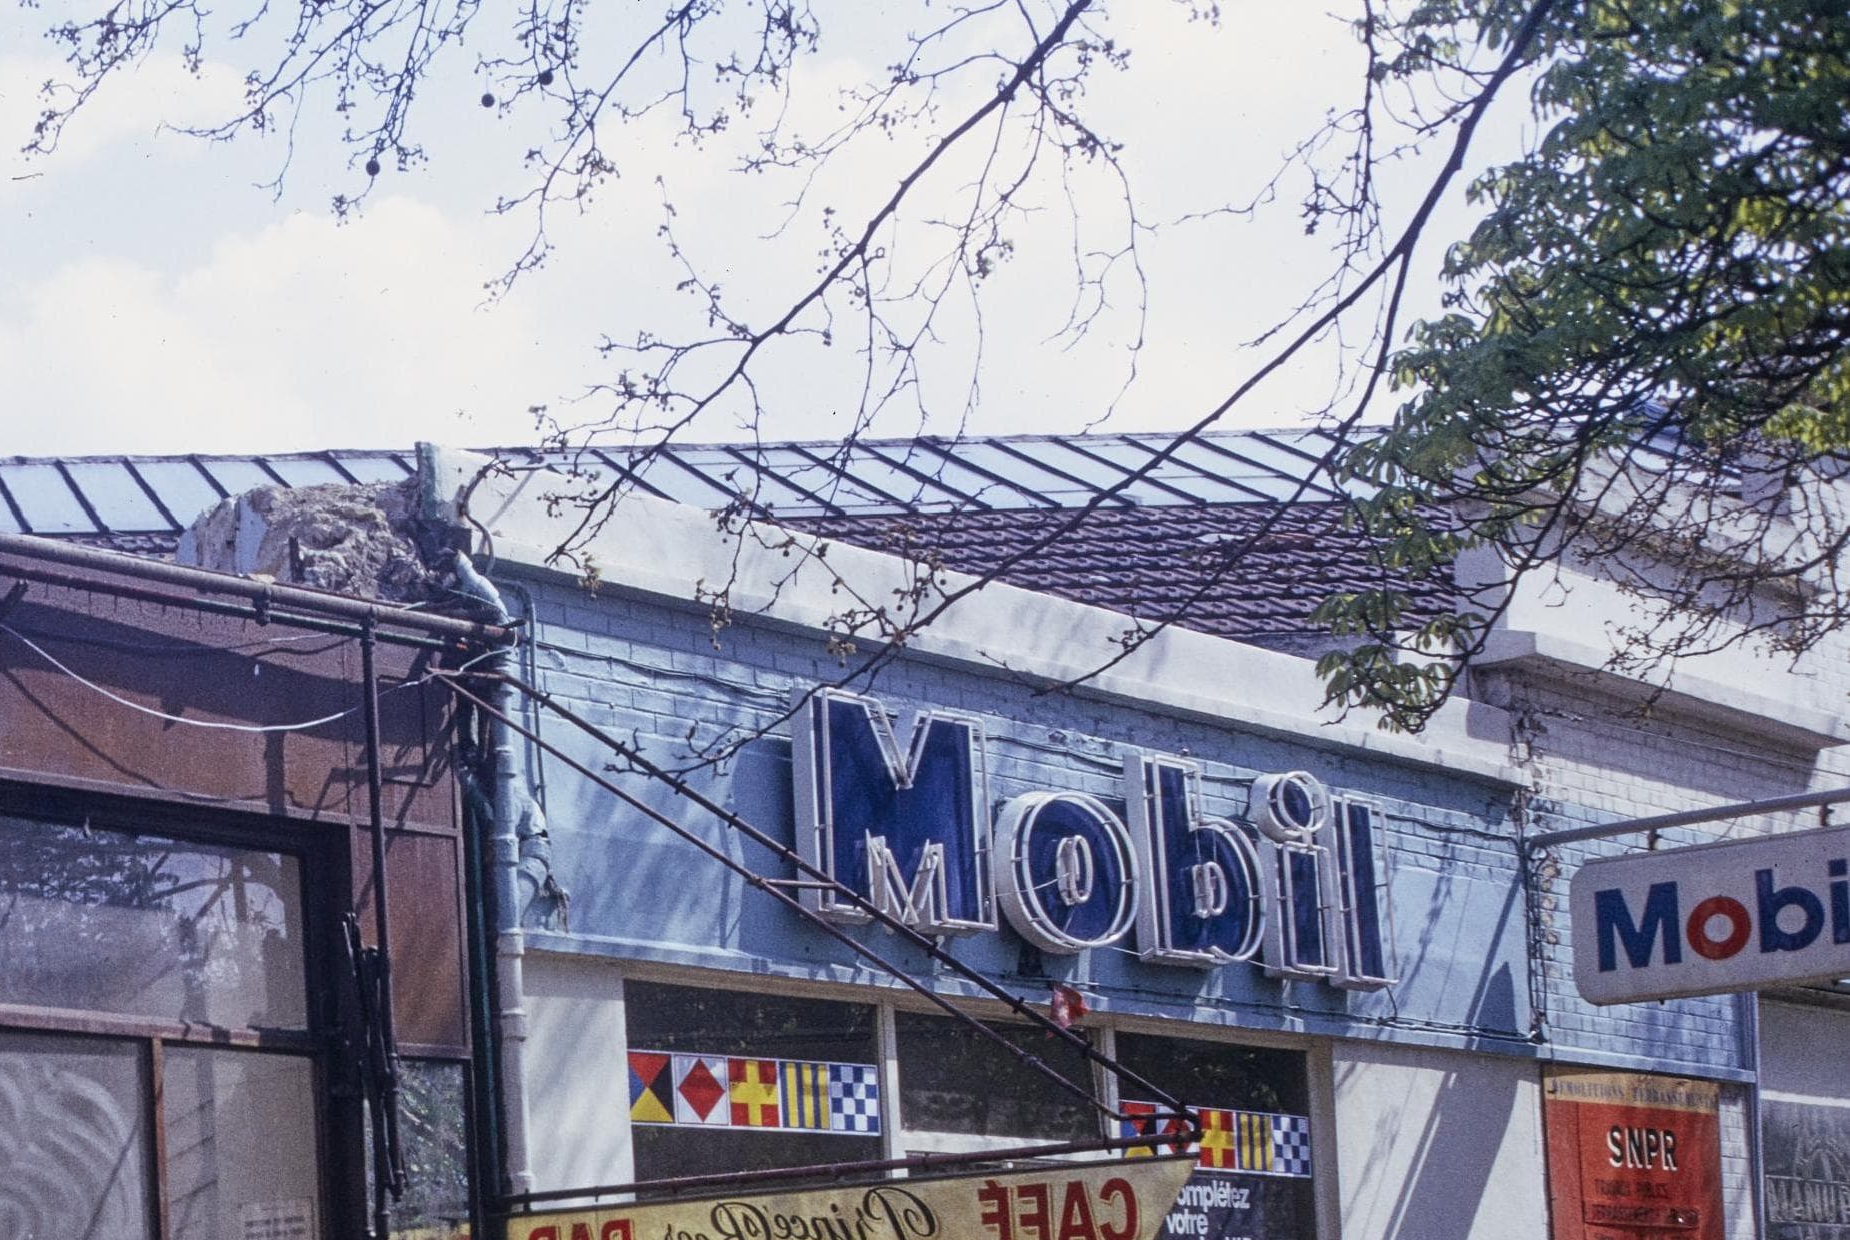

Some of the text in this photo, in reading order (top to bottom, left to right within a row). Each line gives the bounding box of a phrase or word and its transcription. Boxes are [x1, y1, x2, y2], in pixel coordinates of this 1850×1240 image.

[791, 688, 1398, 990] Mobil
[1606, 1125, 1678, 1171] SNPR
[1175, 1180, 1251, 1211] omplétez
[1166, 1210, 1208, 1235] votre
